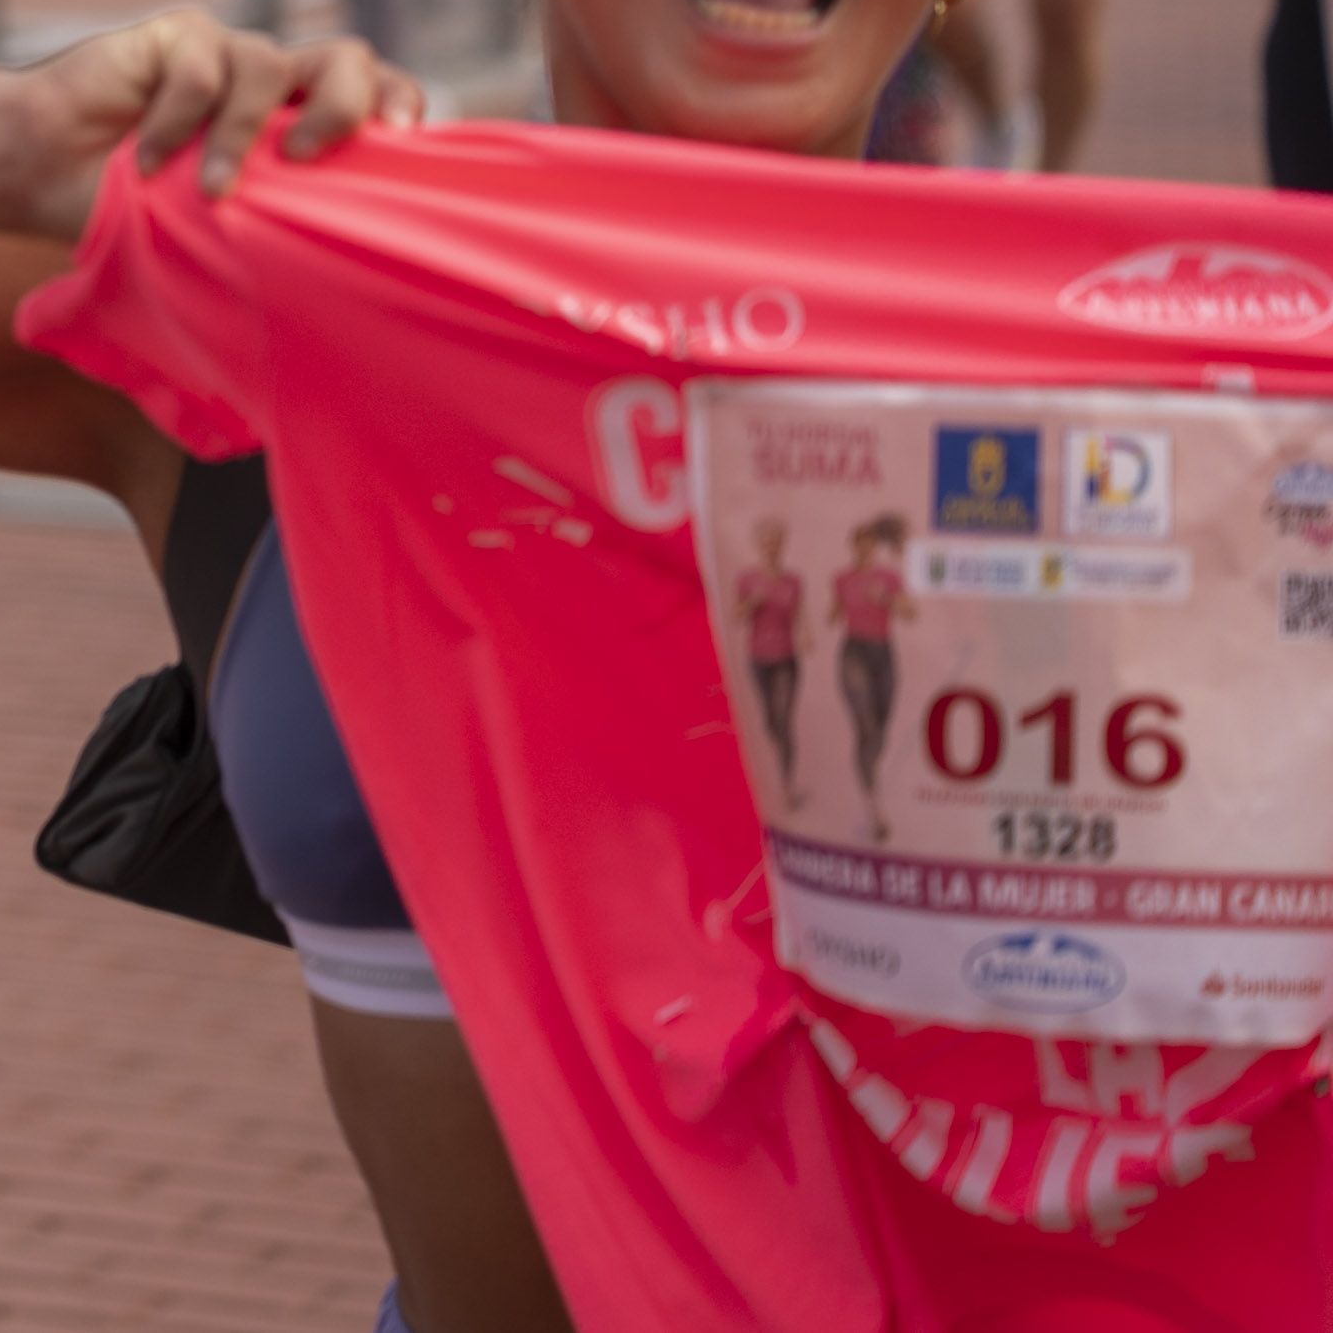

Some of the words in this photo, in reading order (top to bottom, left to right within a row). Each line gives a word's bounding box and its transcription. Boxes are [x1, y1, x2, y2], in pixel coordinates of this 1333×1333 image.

[924, 686, 1190, 792] 016
[994, 811, 1118, 863] 1328
[926, 868, 974, 907] LA
[978, 871, 1098, 915] MUJER
[1122, 876, 1224, 918] GRAN
